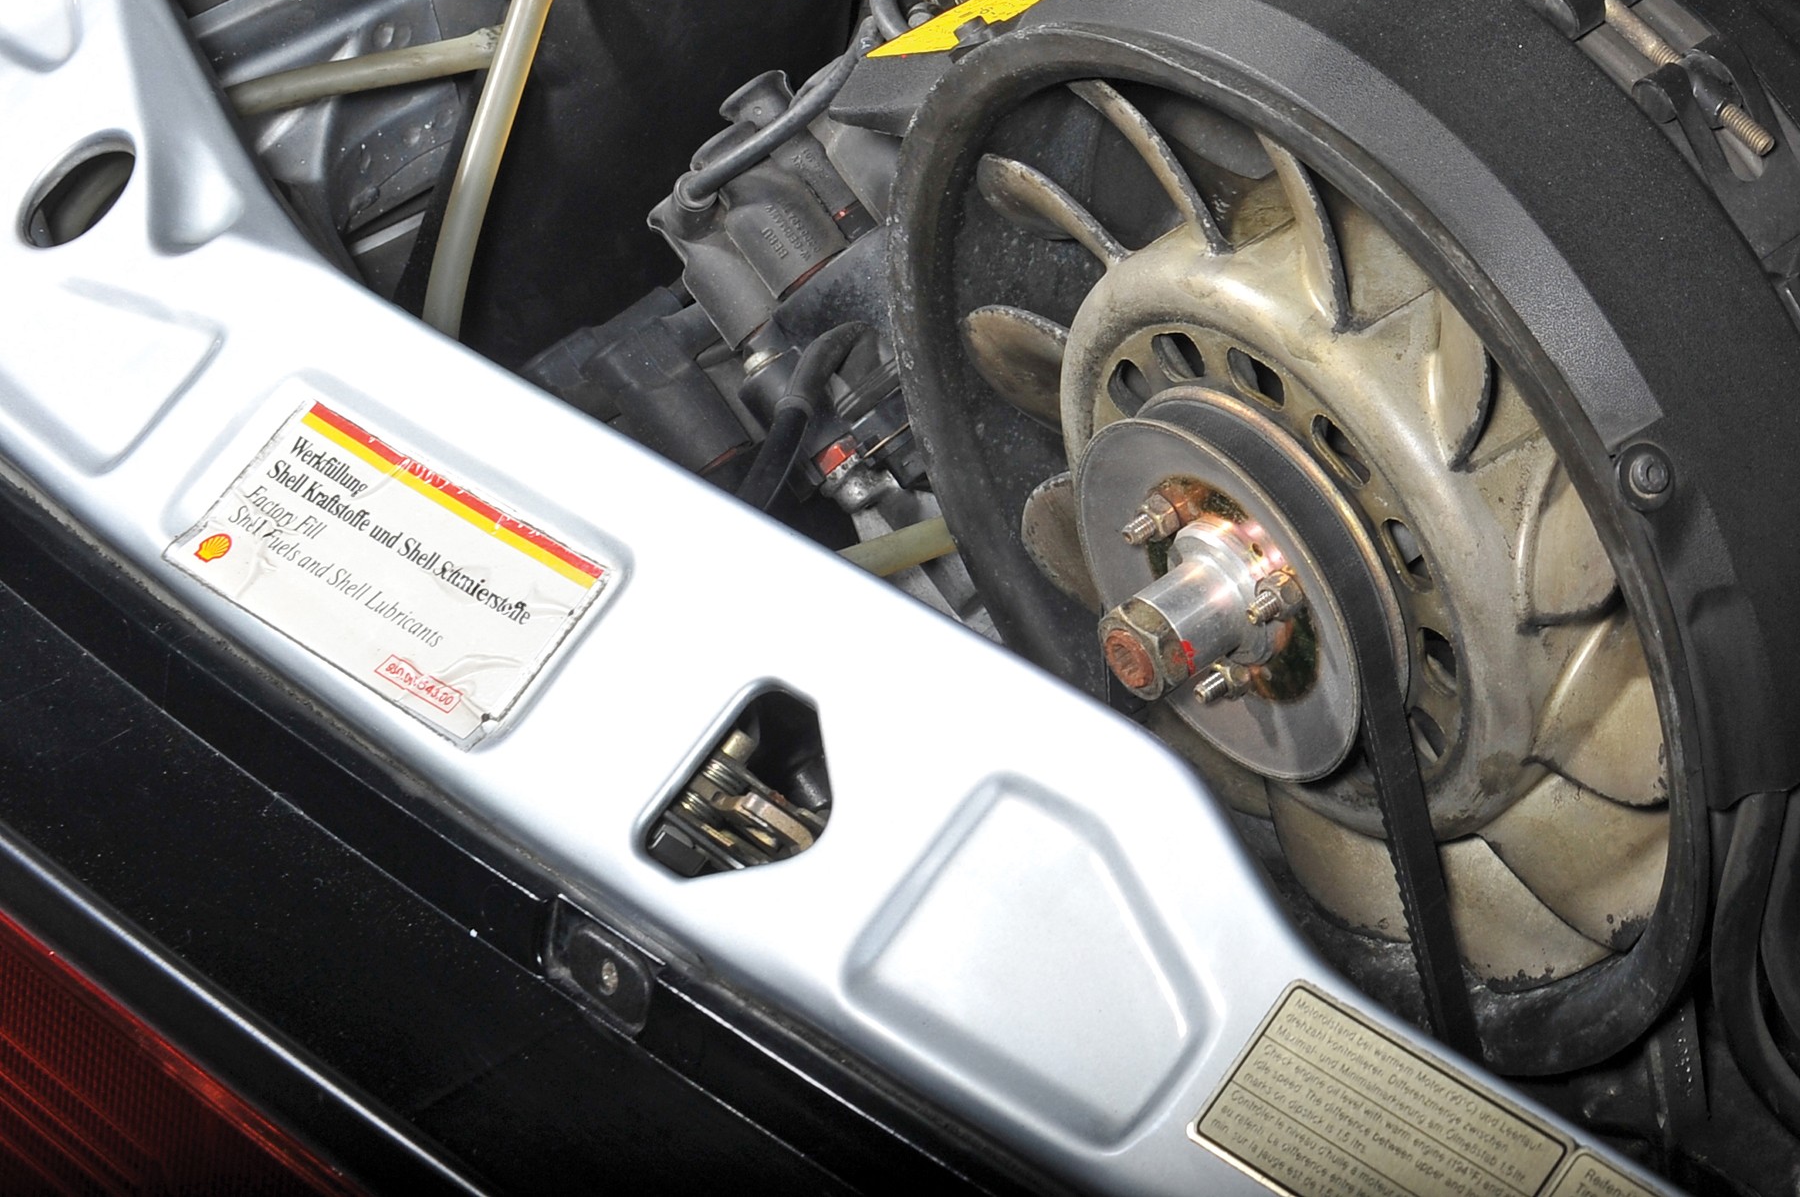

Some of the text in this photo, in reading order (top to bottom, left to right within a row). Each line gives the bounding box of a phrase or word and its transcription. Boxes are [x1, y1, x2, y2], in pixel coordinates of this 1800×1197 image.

[761, 226, 790, 260] BERU
[290, 435, 368, 498] Werkfüllung
[244, 485, 327, 539] Factory Fill
[266, 459, 310, 493] Shell
[301, 480, 370, 532] Kraftstoffe
[369, 525, 404, 549] und
[397, 537, 441, 571] Shell
[262, 528, 299, 561] Fuels
[297, 557, 334, 578] and
[326, 568, 372, 600] Shell
[364, 591, 443, 647] Lubricants
[1243, 1072, 1273, 1094] marks
[1273, 1092, 1286, 1103] on
[1286, 1099, 1324, 1127] dipstick
[1324, 1122, 1335, 1133] is
[1262, 1043, 1293, 1068] Check
[1292, 1065, 1325, 1090] engine
[1325, 1083, 1340, 1096] oil
[1339, 1091, 1363, 1110] level
[1362, 1106, 1384, 1123] with
[1384, 1121, 1410, 1140] warm
[1411, 1137, 1446, 1163] engine
[1483, 1180, 1503, 1196] and
[1318, 1051, 1338, 1069] und
[1337, 1063, 1427, 1124] Minimalmarkierung
[1427, 1120, 1443, 1133] am
[1374, 1047, 1414, 1076] warmem
[1415, 1071, 1444, 1094] Motor
[1478, 1109, 1499, 1126] und
[1385, 1073, 1463, 1126] Differenzmenge
[1463, 1119, 1509, 1152] zwischen
[1220, 1104, 1233, 1116] au
[1267, 1133, 1280, 1145] La
[1328, 1173, 1355, 1193] entre
[1231, 1133, 1246, 1145] sur
[1248, 1142, 1258, 1152] la
[1256, 1148, 1285, 1171] jauge
[1286, 1166, 1302, 1179] est
[1302, 1176, 1317, 1189] de
[1275, 1117, 1286, 1128] le
[1286, 1124, 1318, 1148] niveau
[1358, 1171, 1394, 1197] moteur
[1304, 1089, 1323, 1105] The
[1322, 1101, 1372, 1135] difference
[1371, 1131, 1414, 1162] between
[1414, 1159, 1443, 1181] upper
[1444, 1177, 1465, 1193] and
